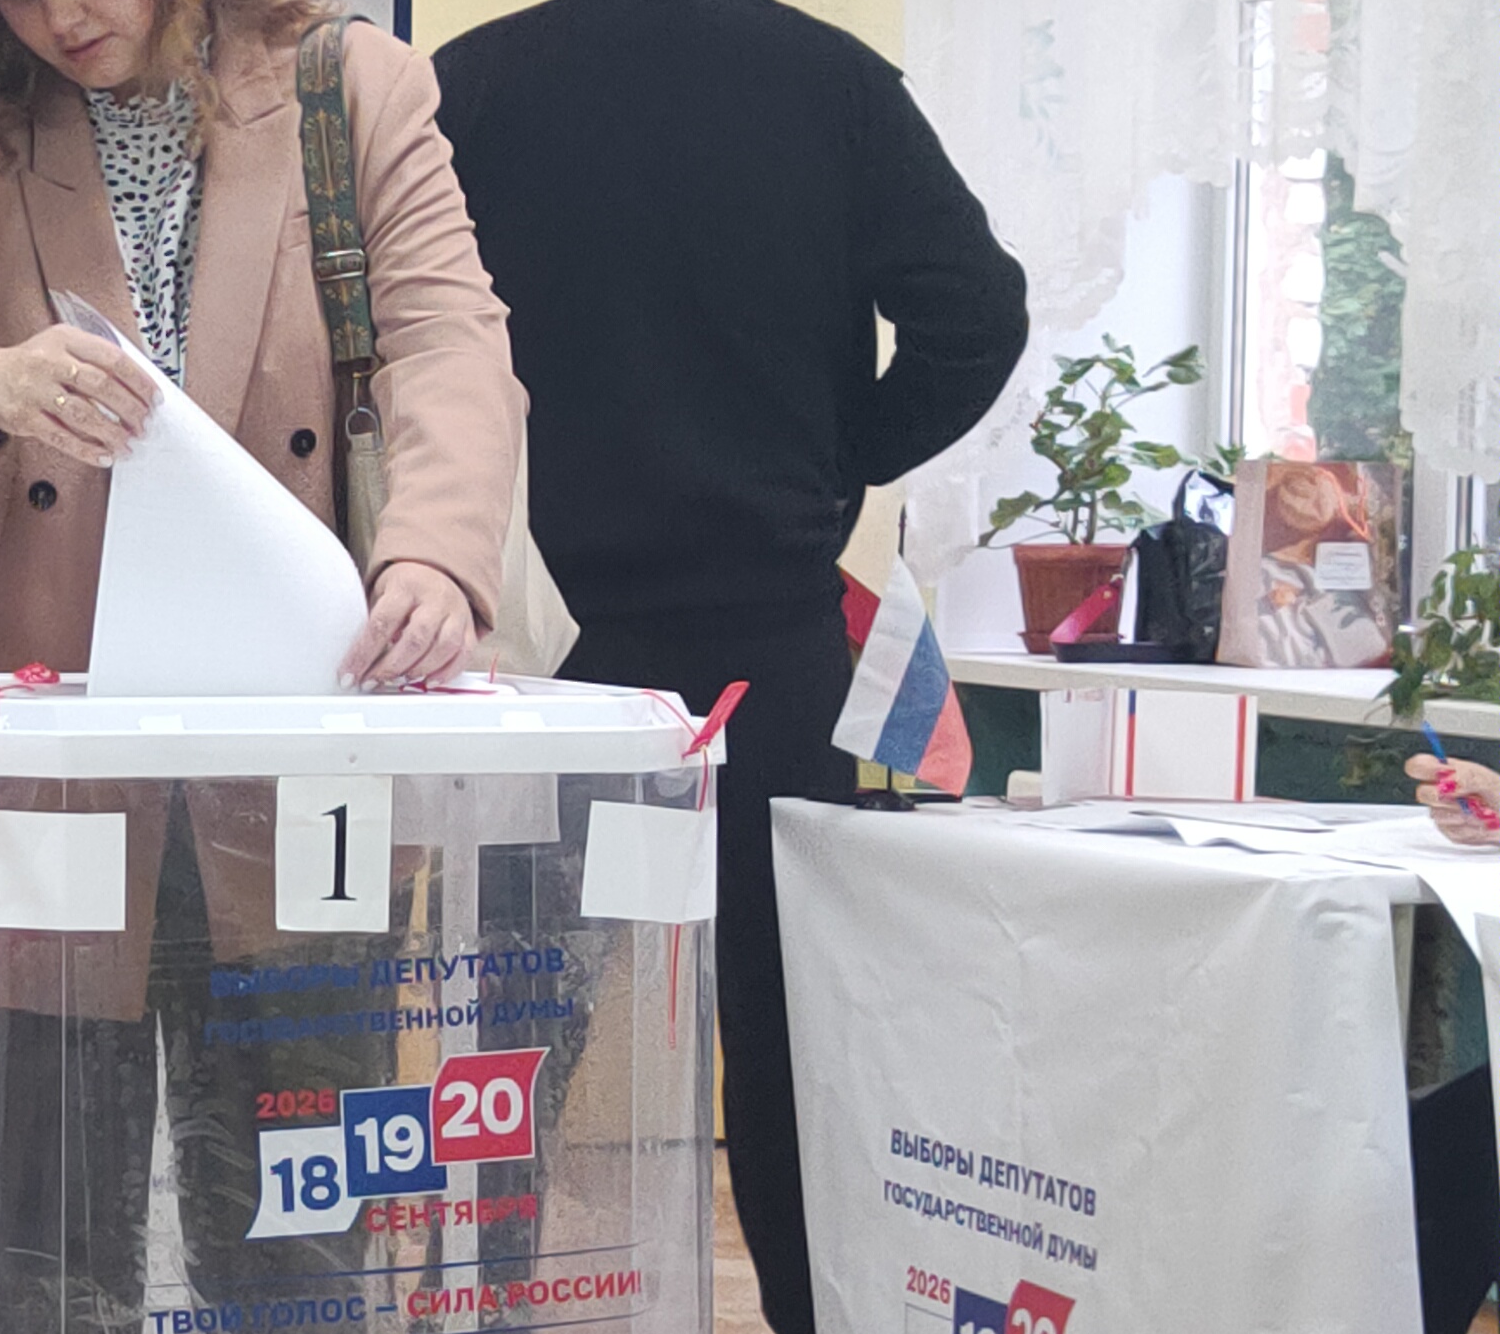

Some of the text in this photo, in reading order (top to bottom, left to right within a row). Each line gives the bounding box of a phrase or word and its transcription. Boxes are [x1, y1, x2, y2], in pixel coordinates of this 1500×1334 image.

[321, 803, 358, 901] 1
[370, 947, 565, 989] ДЕПУТАТОВ
[491, 997, 574, 1027] ДУМЫ
[256, 1091, 337, 1119] 2026
[268, 1076, 524, 1213] 18 19 20
[891, 1128, 1097, 1218] ВЫБОРЫ ДЕПУТАТОВ
[884, 1179, 1098, 1271] ГОСУДАРСТВЕННОЙ ДУМЫ
[252, 1295, 367, 1331] ГОЛОС
[407, 1282, 497, 1318] СИЛА
[506, 1269, 642, 1307] РОССИИ!
[906, 1266, 951, 1305] 2026
